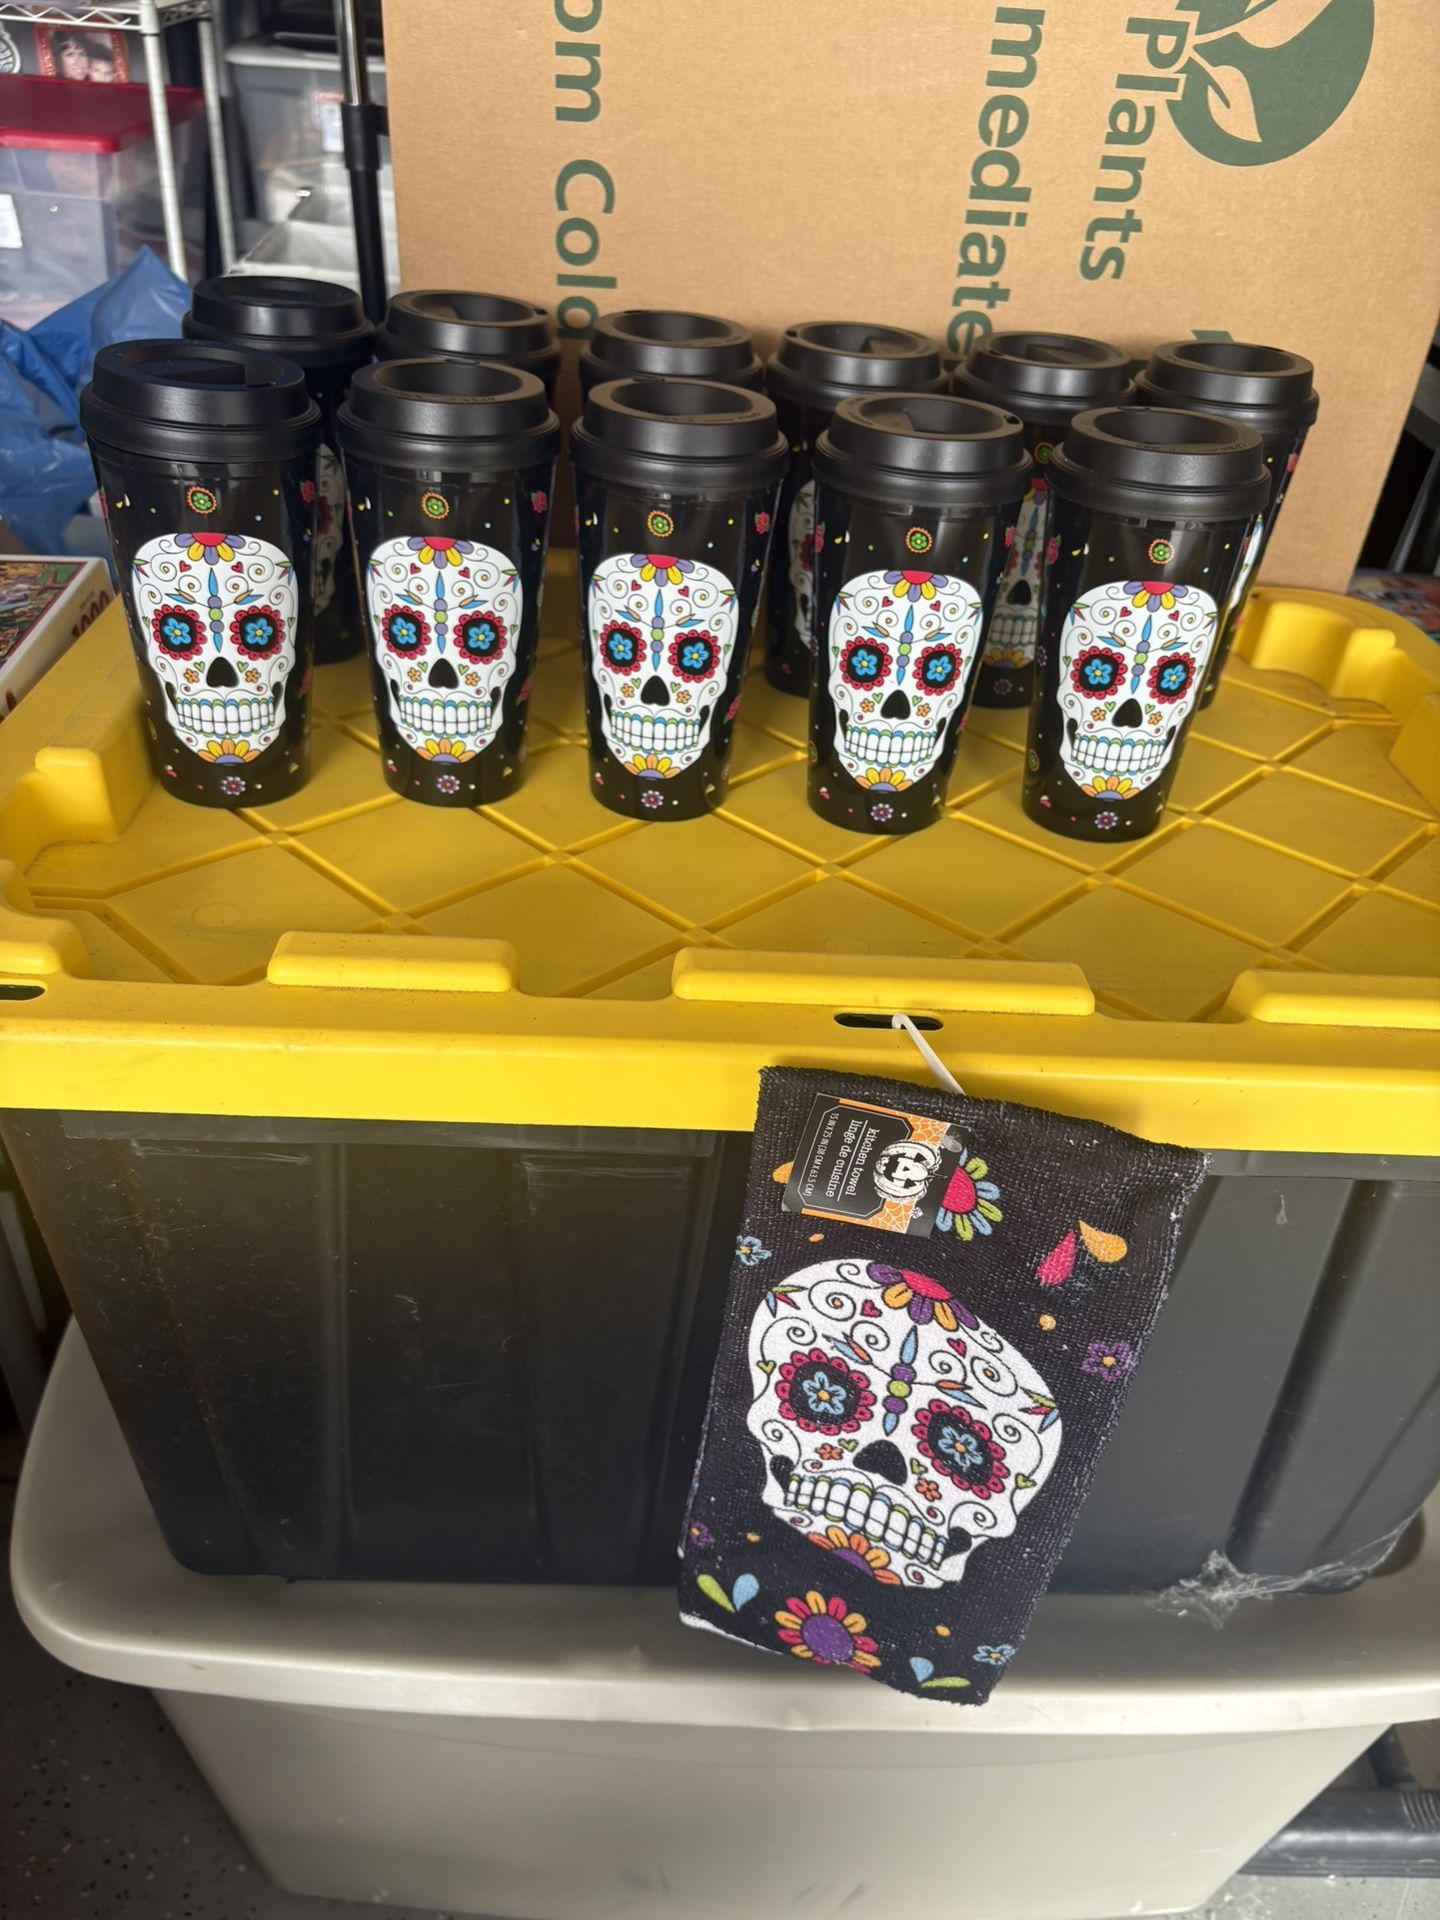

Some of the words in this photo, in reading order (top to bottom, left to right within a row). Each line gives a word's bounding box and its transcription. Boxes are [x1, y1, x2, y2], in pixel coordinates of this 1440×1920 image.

[1080, 17, 1190, 281] Plants
[945, 7, 1045, 372] mediate
[843, 1120, 863, 1144] linge
[855, 1128, 880, 1165] kitchen
[839, 1145, 852, 1158] de
[825, 1159, 845, 1197] cuisine
[845, 1167, 864, 1196] towel
